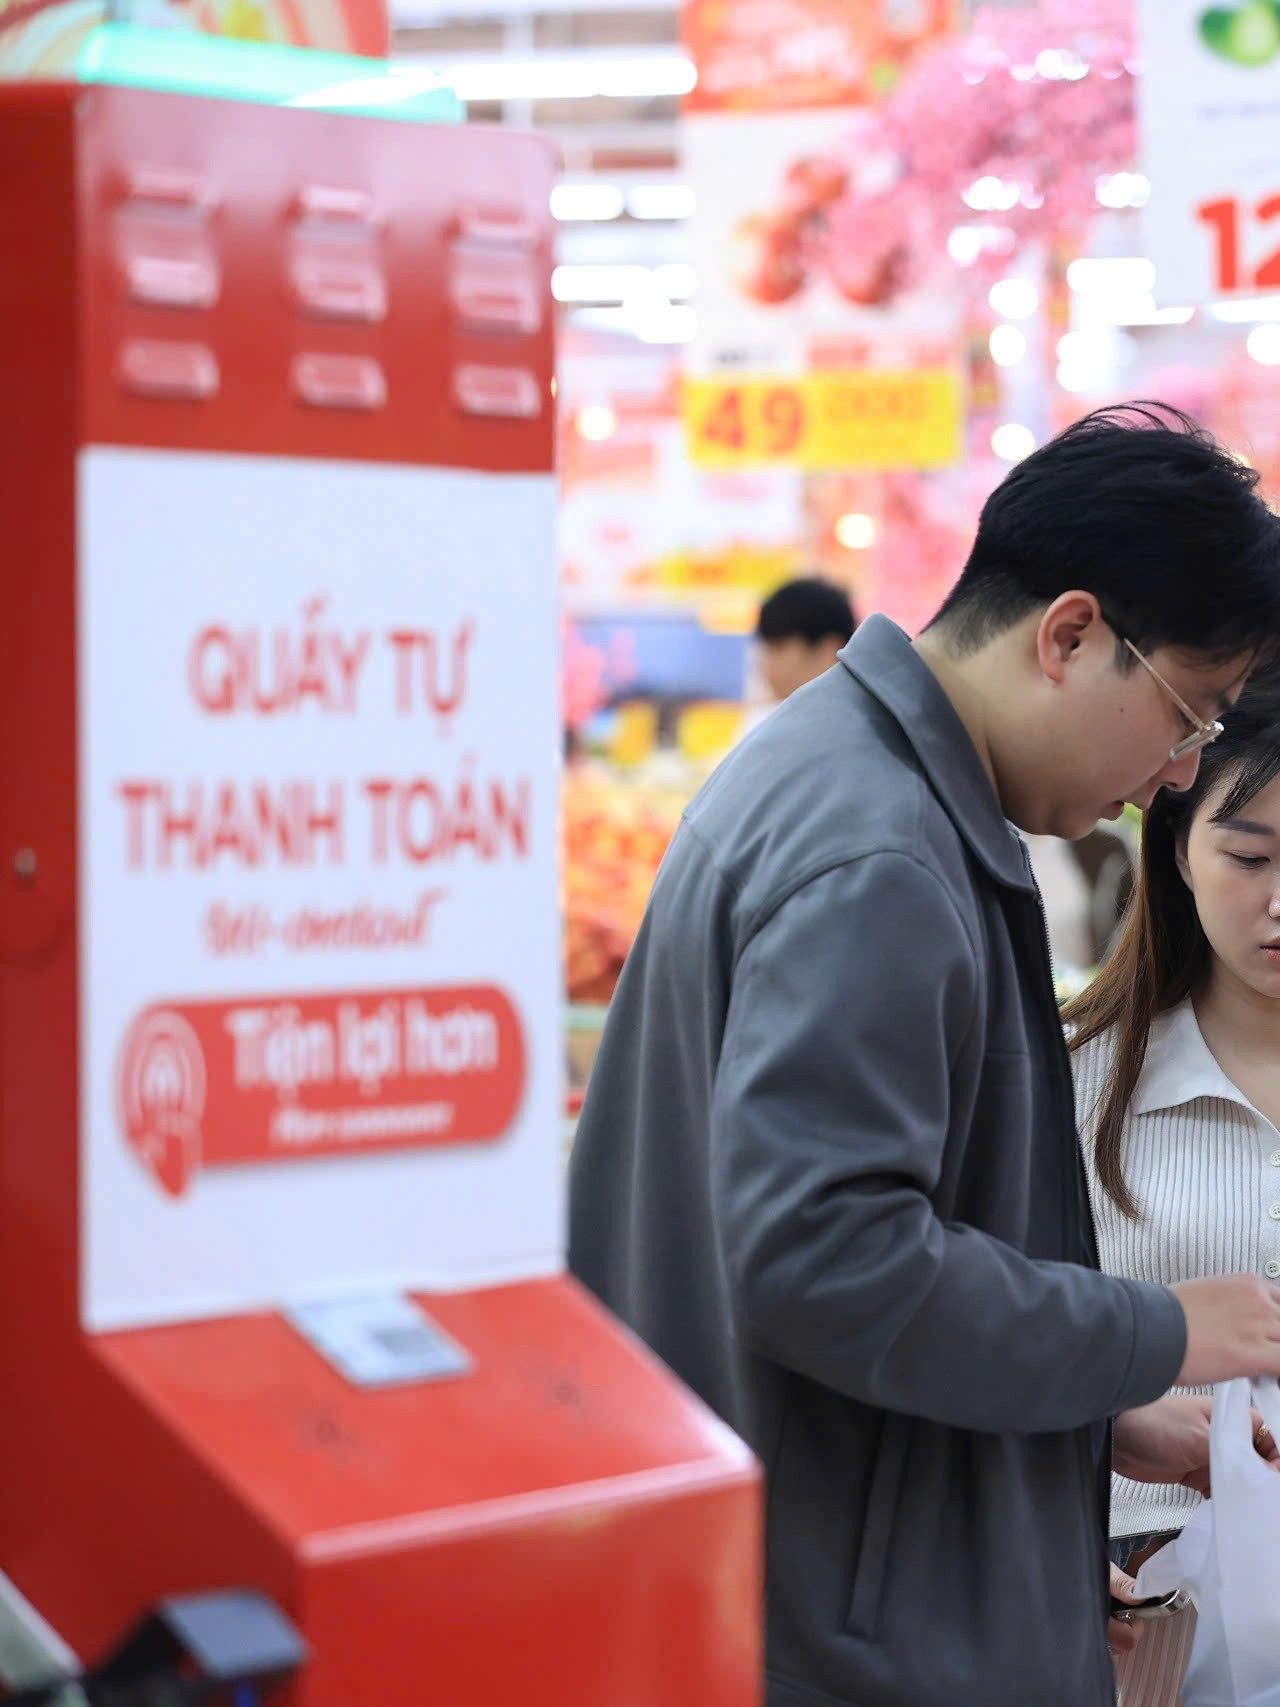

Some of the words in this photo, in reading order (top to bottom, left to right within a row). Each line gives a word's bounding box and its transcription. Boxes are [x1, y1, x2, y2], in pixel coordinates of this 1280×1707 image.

[702, 386, 807, 455] 49
[115, 778, 346, 871] THANH
[363, 750, 533, 863] TOÁN
[225, 1004, 337, 1104] Tiện
[404, 998, 501, 1077] hơn
